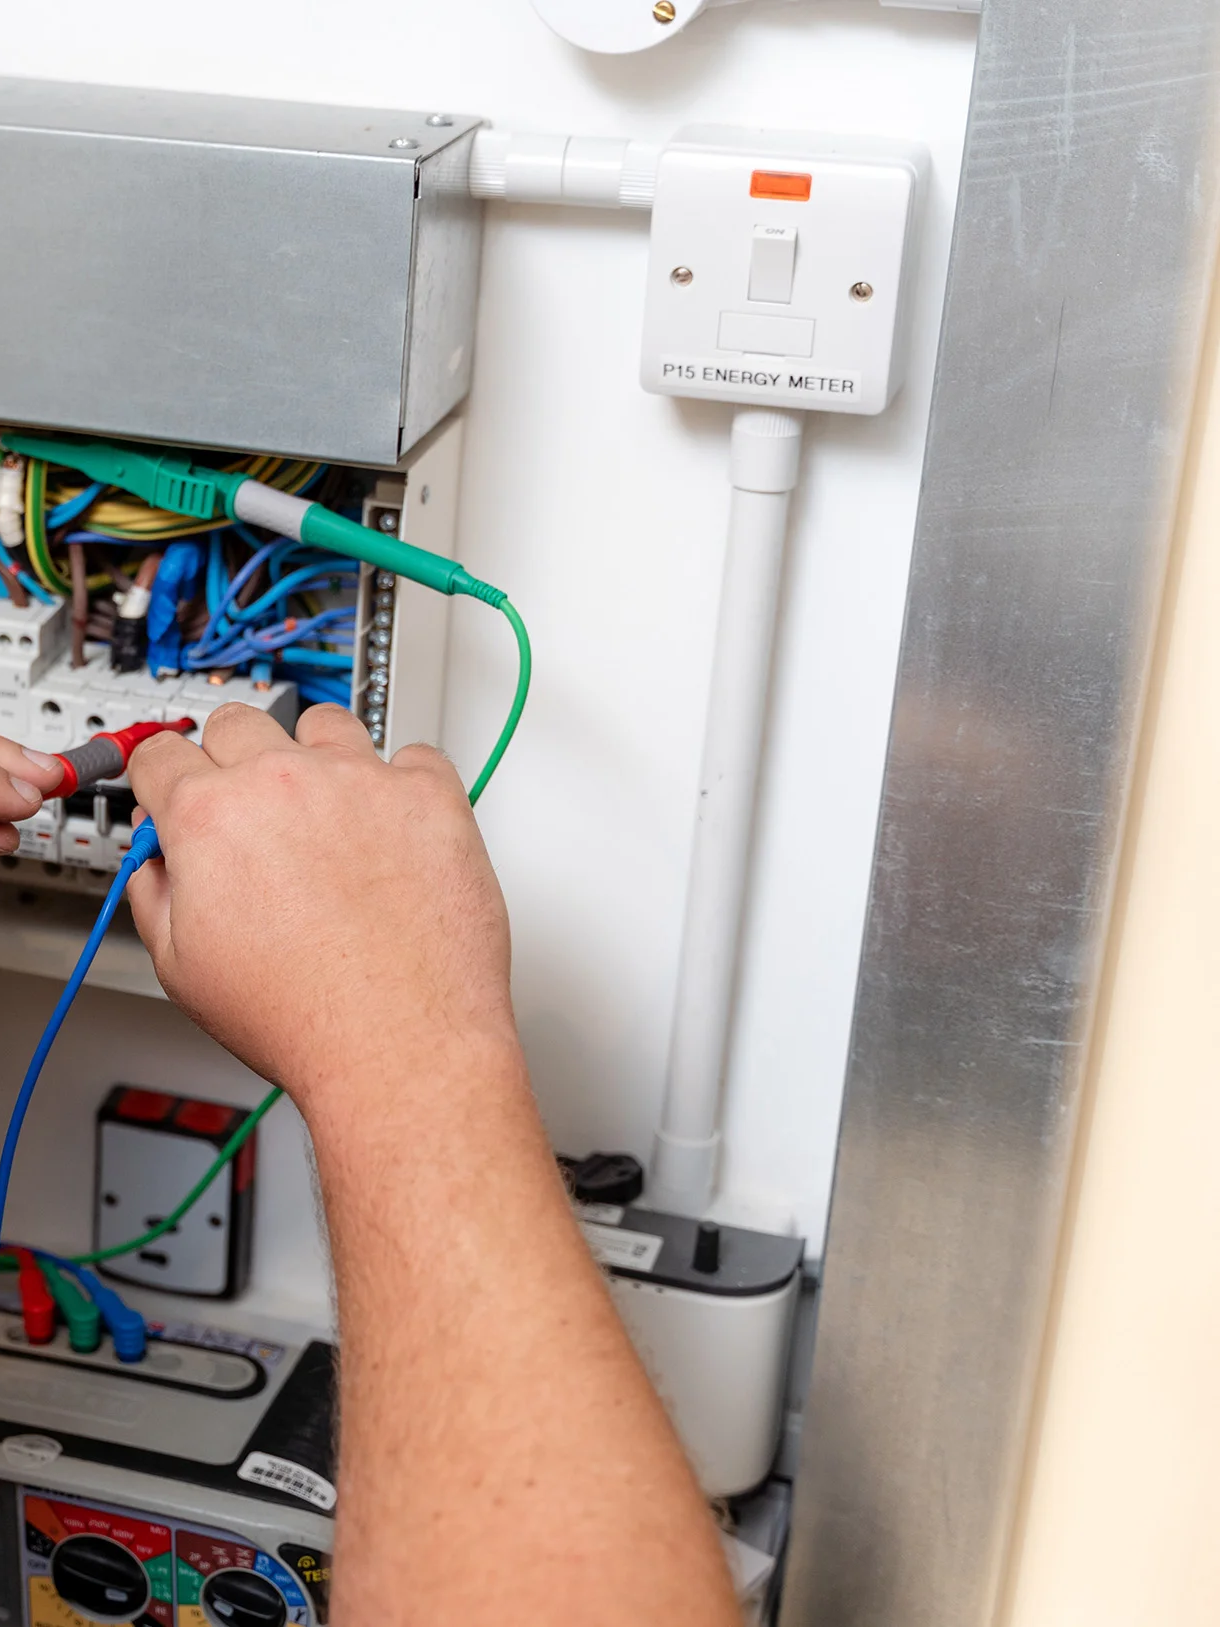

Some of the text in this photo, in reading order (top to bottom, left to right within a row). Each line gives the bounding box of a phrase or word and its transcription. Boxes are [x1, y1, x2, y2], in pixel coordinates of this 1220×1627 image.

[662, 363, 855, 394] P15 ENERGY METER
[302, 1567, 331, 1583] TES
